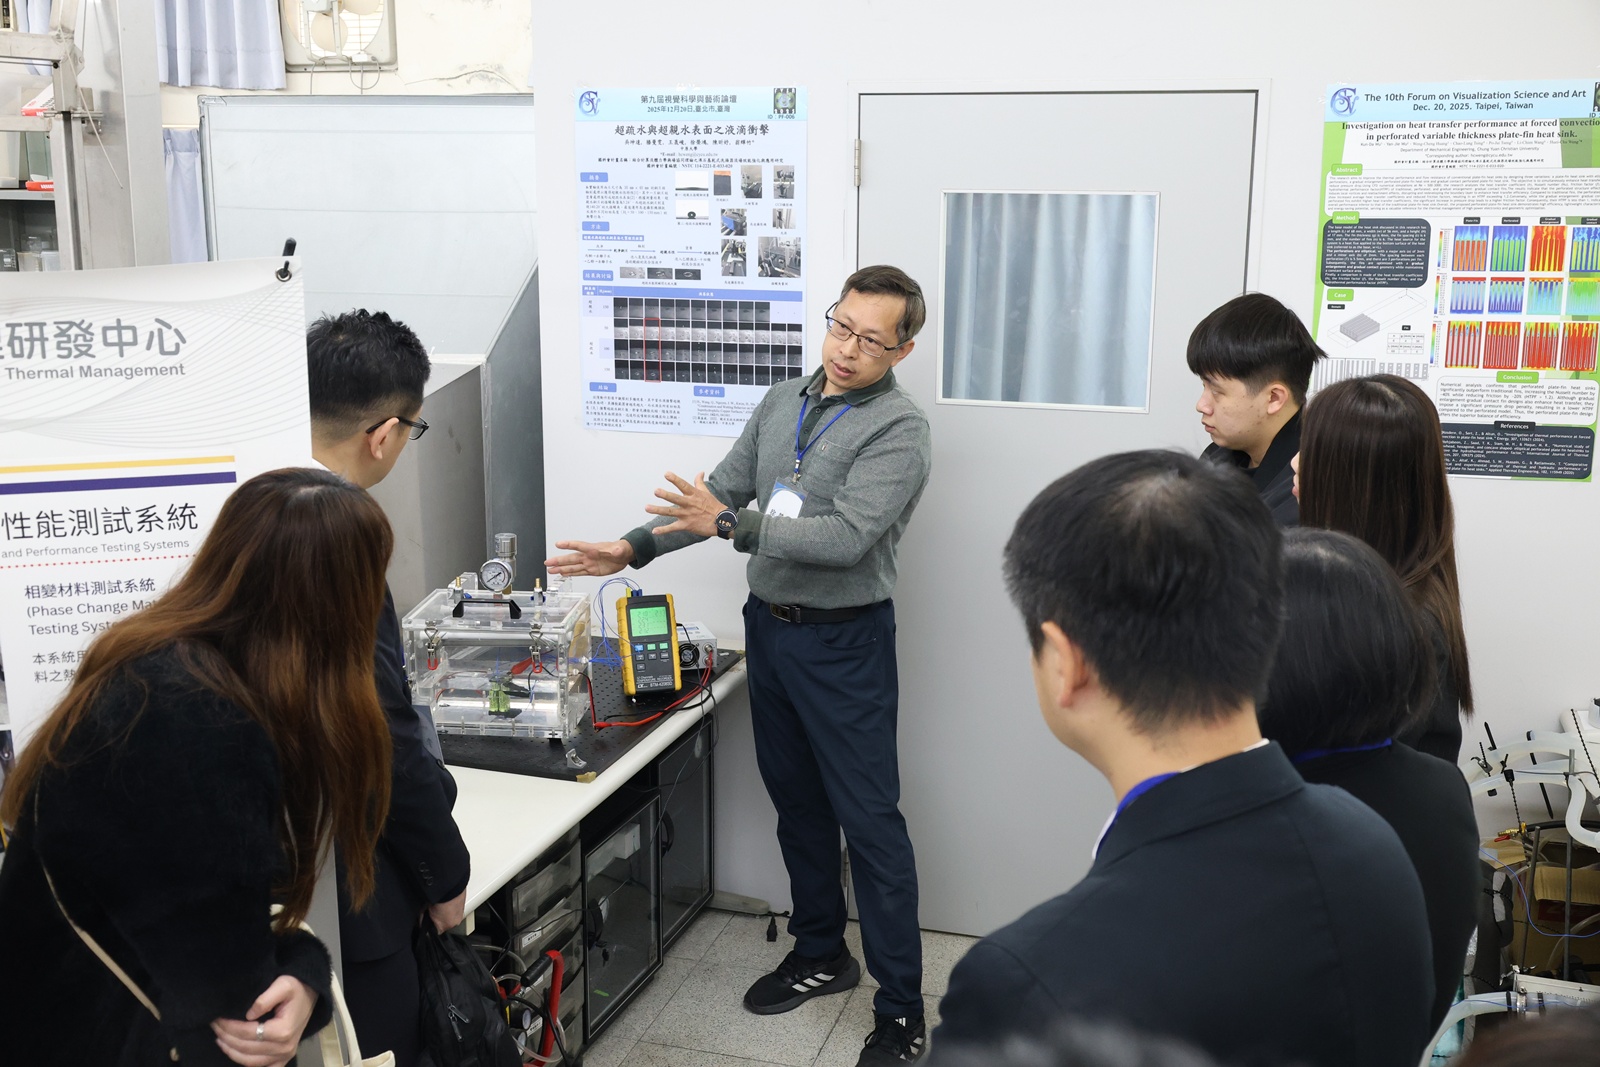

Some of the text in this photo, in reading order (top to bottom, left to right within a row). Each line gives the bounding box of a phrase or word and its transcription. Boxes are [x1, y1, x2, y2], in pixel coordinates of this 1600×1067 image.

[1453, 92, 1510, 100] Visualization
[1476, 103, 1501, 111] Taipei,
[1342, 122, 1393, 131] Investigation
[1464, 120, 1517, 129] performance
[1376, 133, 1419, 141] perforated
[1498, 131, 1533, 140] plate-fin
[0, 318, 187, 360] 研發中心
[5, 363, 185, 381] Thermal Management
[1, 503, 198, 540] 性能測試系統
[1, 540, 190, 558] and Performance Testing Systems
[25, 578, 156, 599] 相變材料測試系統
[27, 604, 72, 619] (Phase
[77, 601, 127, 615] Change
[29, 622, 78, 637] Testing
